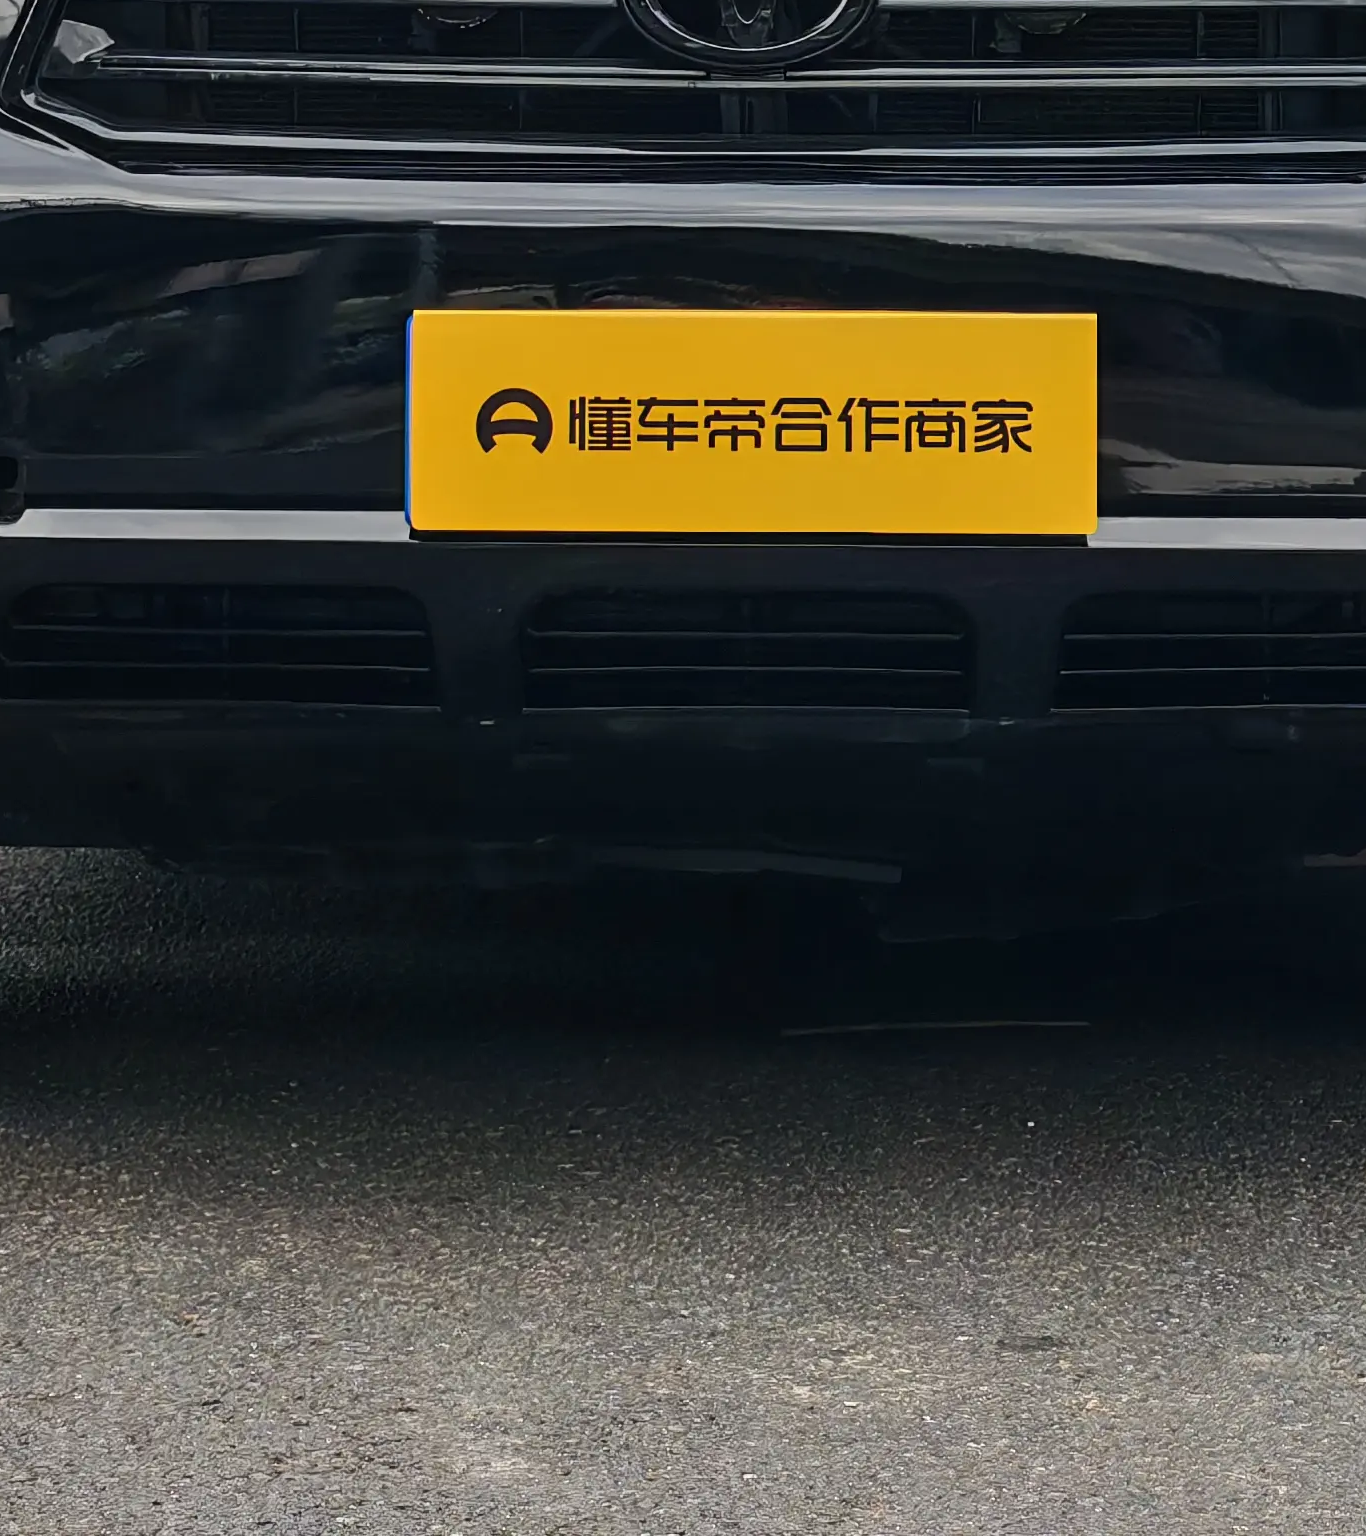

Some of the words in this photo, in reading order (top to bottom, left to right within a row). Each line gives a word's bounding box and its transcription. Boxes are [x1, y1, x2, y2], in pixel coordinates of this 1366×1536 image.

[568, 395, 1034, 454] 懂车帝合作商家
